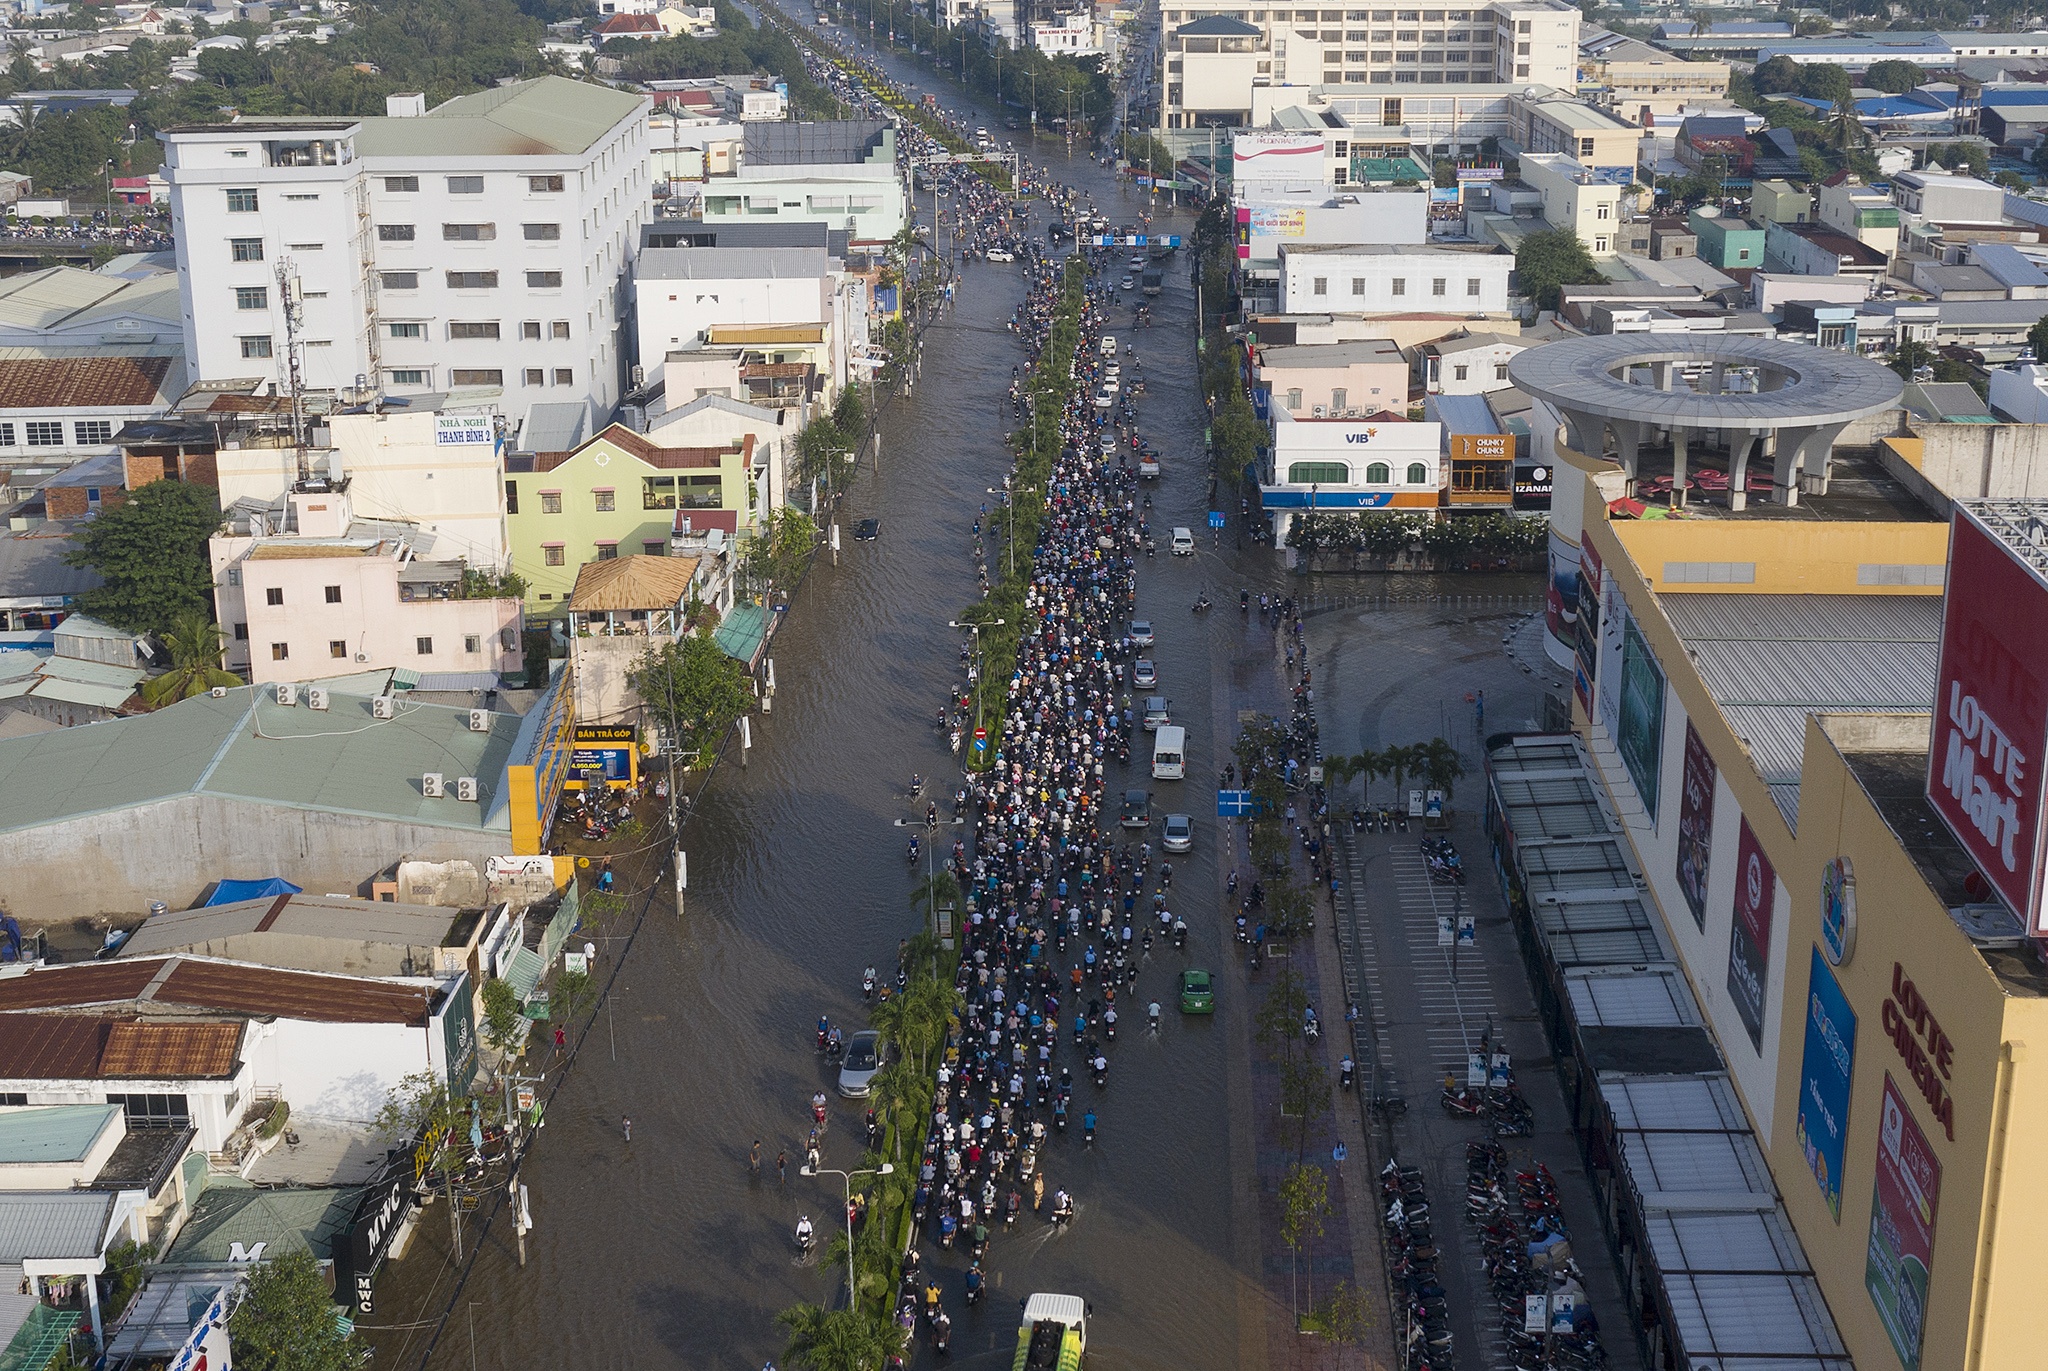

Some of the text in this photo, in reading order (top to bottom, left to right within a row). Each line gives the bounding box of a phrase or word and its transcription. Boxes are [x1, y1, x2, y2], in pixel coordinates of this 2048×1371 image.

[438, 428, 490, 443] THANH BÌNH 2
[1346, 434, 1369, 444] VIB
[578, 729, 631, 737] BÁN TRẢ GÓP
[1950, 680, 2026, 798] LOTTE
[1942, 728, 2020, 872] Mart
[1892, 962, 1954, 1080] LOTTE
[1882, 999, 1955, 1142] CINEMA
[367, 1182, 400, 1256] MWC
[358, 1278, 372, 1312] MWC
